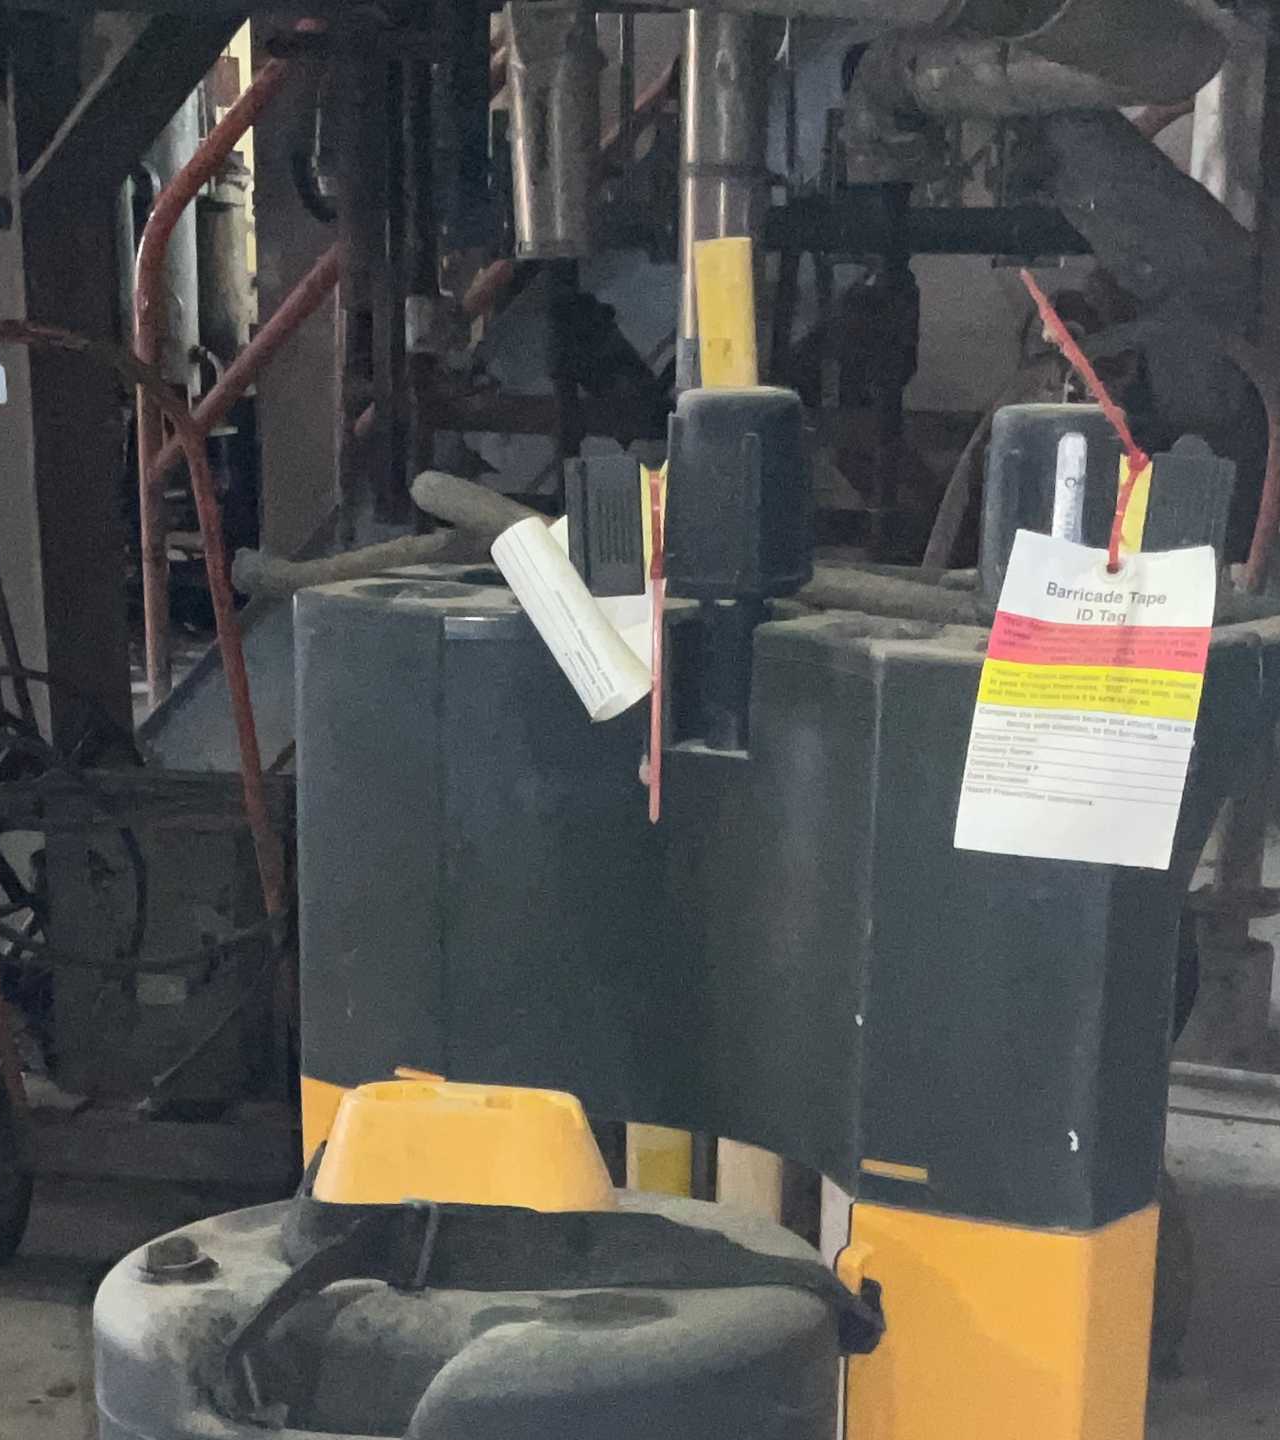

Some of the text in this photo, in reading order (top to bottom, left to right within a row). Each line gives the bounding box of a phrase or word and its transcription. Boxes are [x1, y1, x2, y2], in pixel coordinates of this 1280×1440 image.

[1046, 581, 1168, 608] Barricade Tape
[1076, 607, 1128, 624] ID Tag
